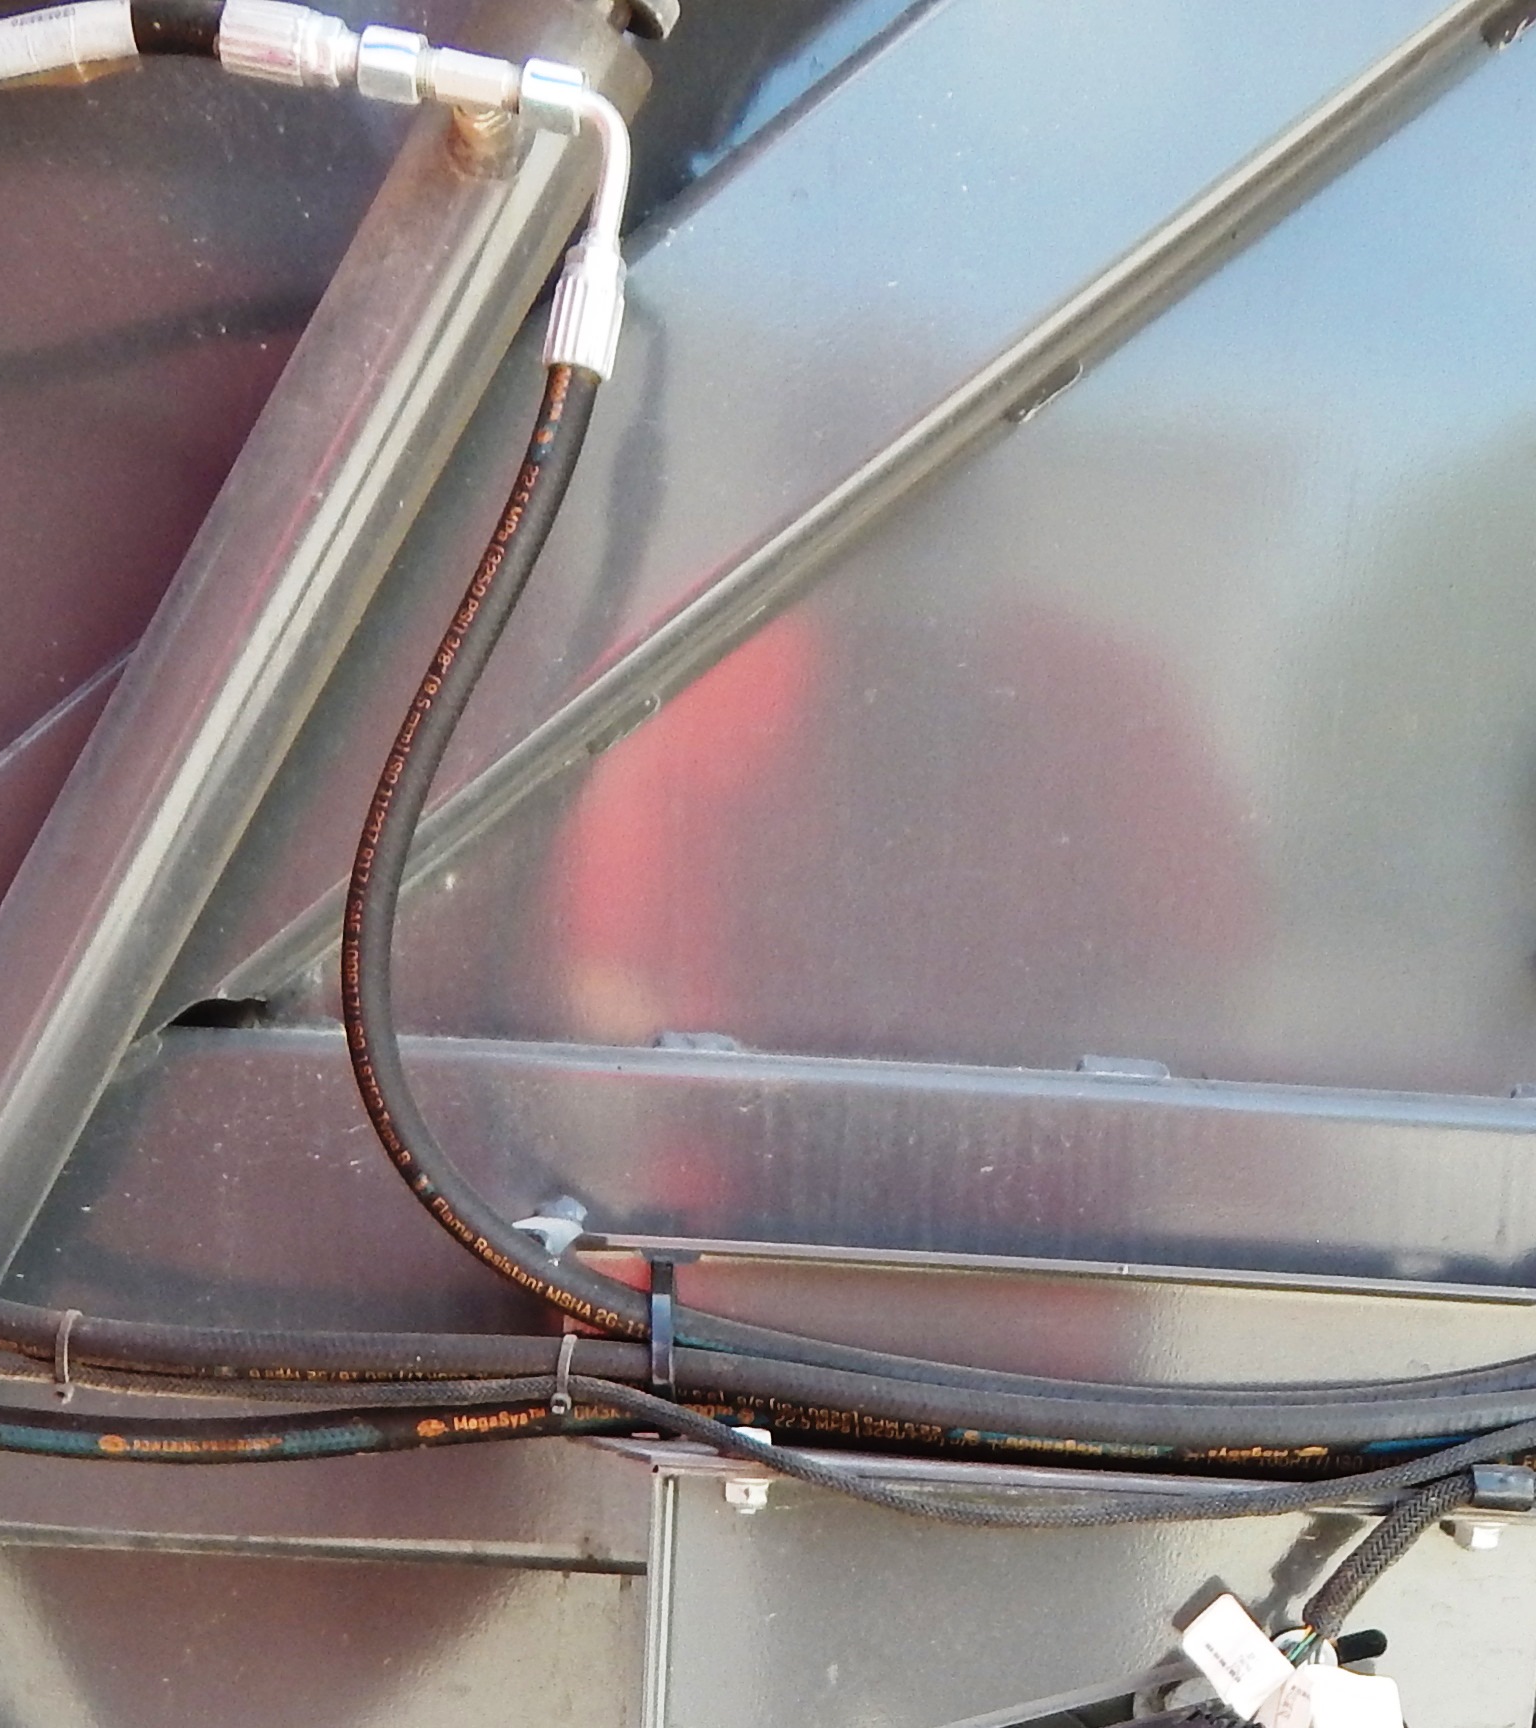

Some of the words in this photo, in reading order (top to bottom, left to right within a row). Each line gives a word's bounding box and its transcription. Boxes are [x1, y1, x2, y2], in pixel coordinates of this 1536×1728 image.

[383, 755, 406, 785] ISO
[431, 1196, 475, 1243] Flame
[473, 1236, 544, 1295] Resistant
[545, 1284, 593, 1319] MSHA
[594, 1308, 651, 1339] 2G-11
